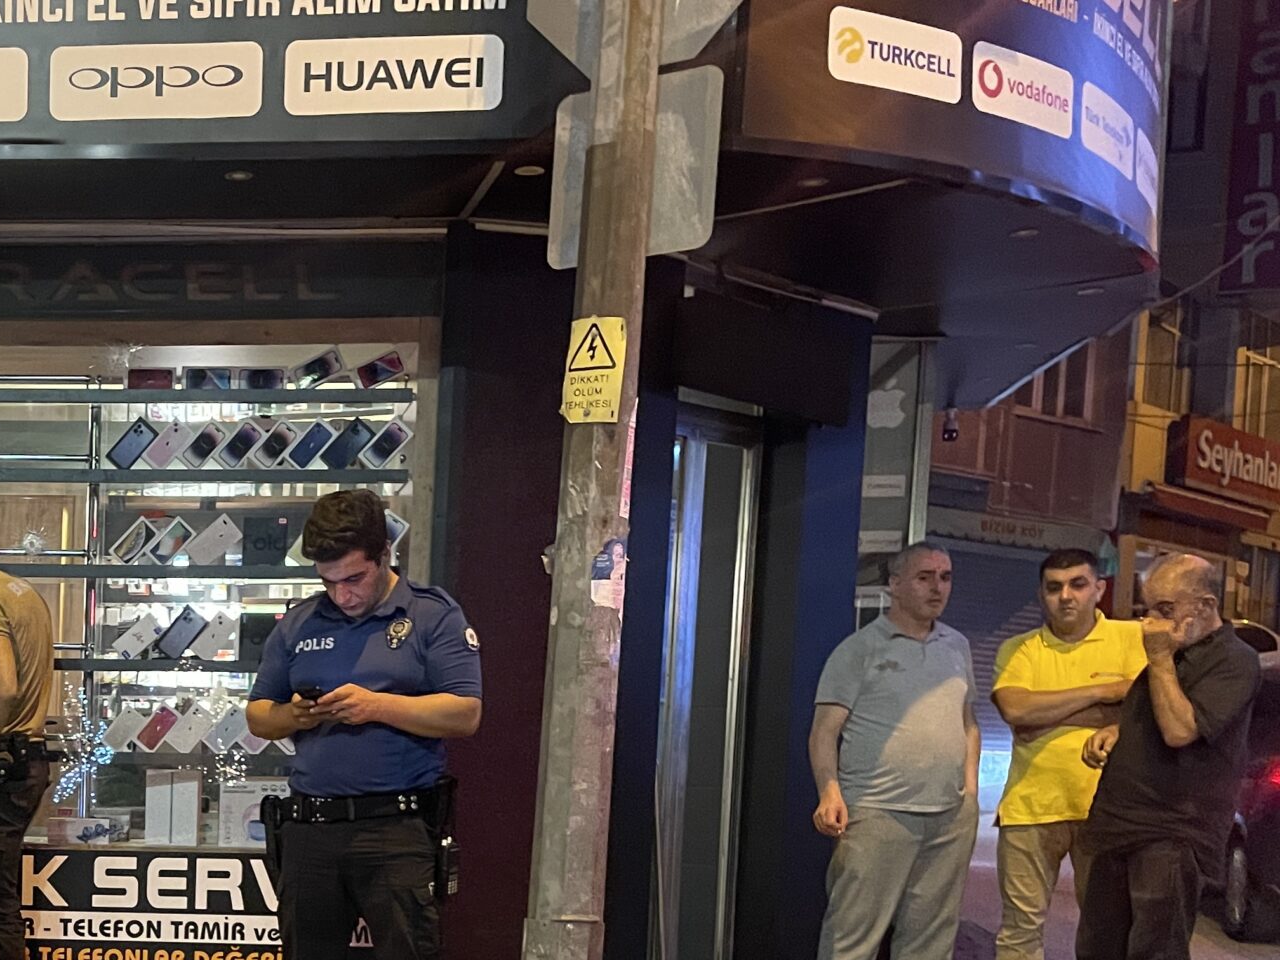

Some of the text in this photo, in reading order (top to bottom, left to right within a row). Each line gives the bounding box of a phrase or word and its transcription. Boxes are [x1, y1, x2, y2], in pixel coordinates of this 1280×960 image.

[303, 57, 485, 94] HUAWEI
[867, 40, 957, 79] TURKCELL
[1007, 77, 1070, 114] vodafone
[1197, 429, 1280, 489] Seyhanla
[92, 856, 279, 912] SERV
[59, 917, 163, 939] TELEFON
[170, 915, 245, 941] TAMİR
